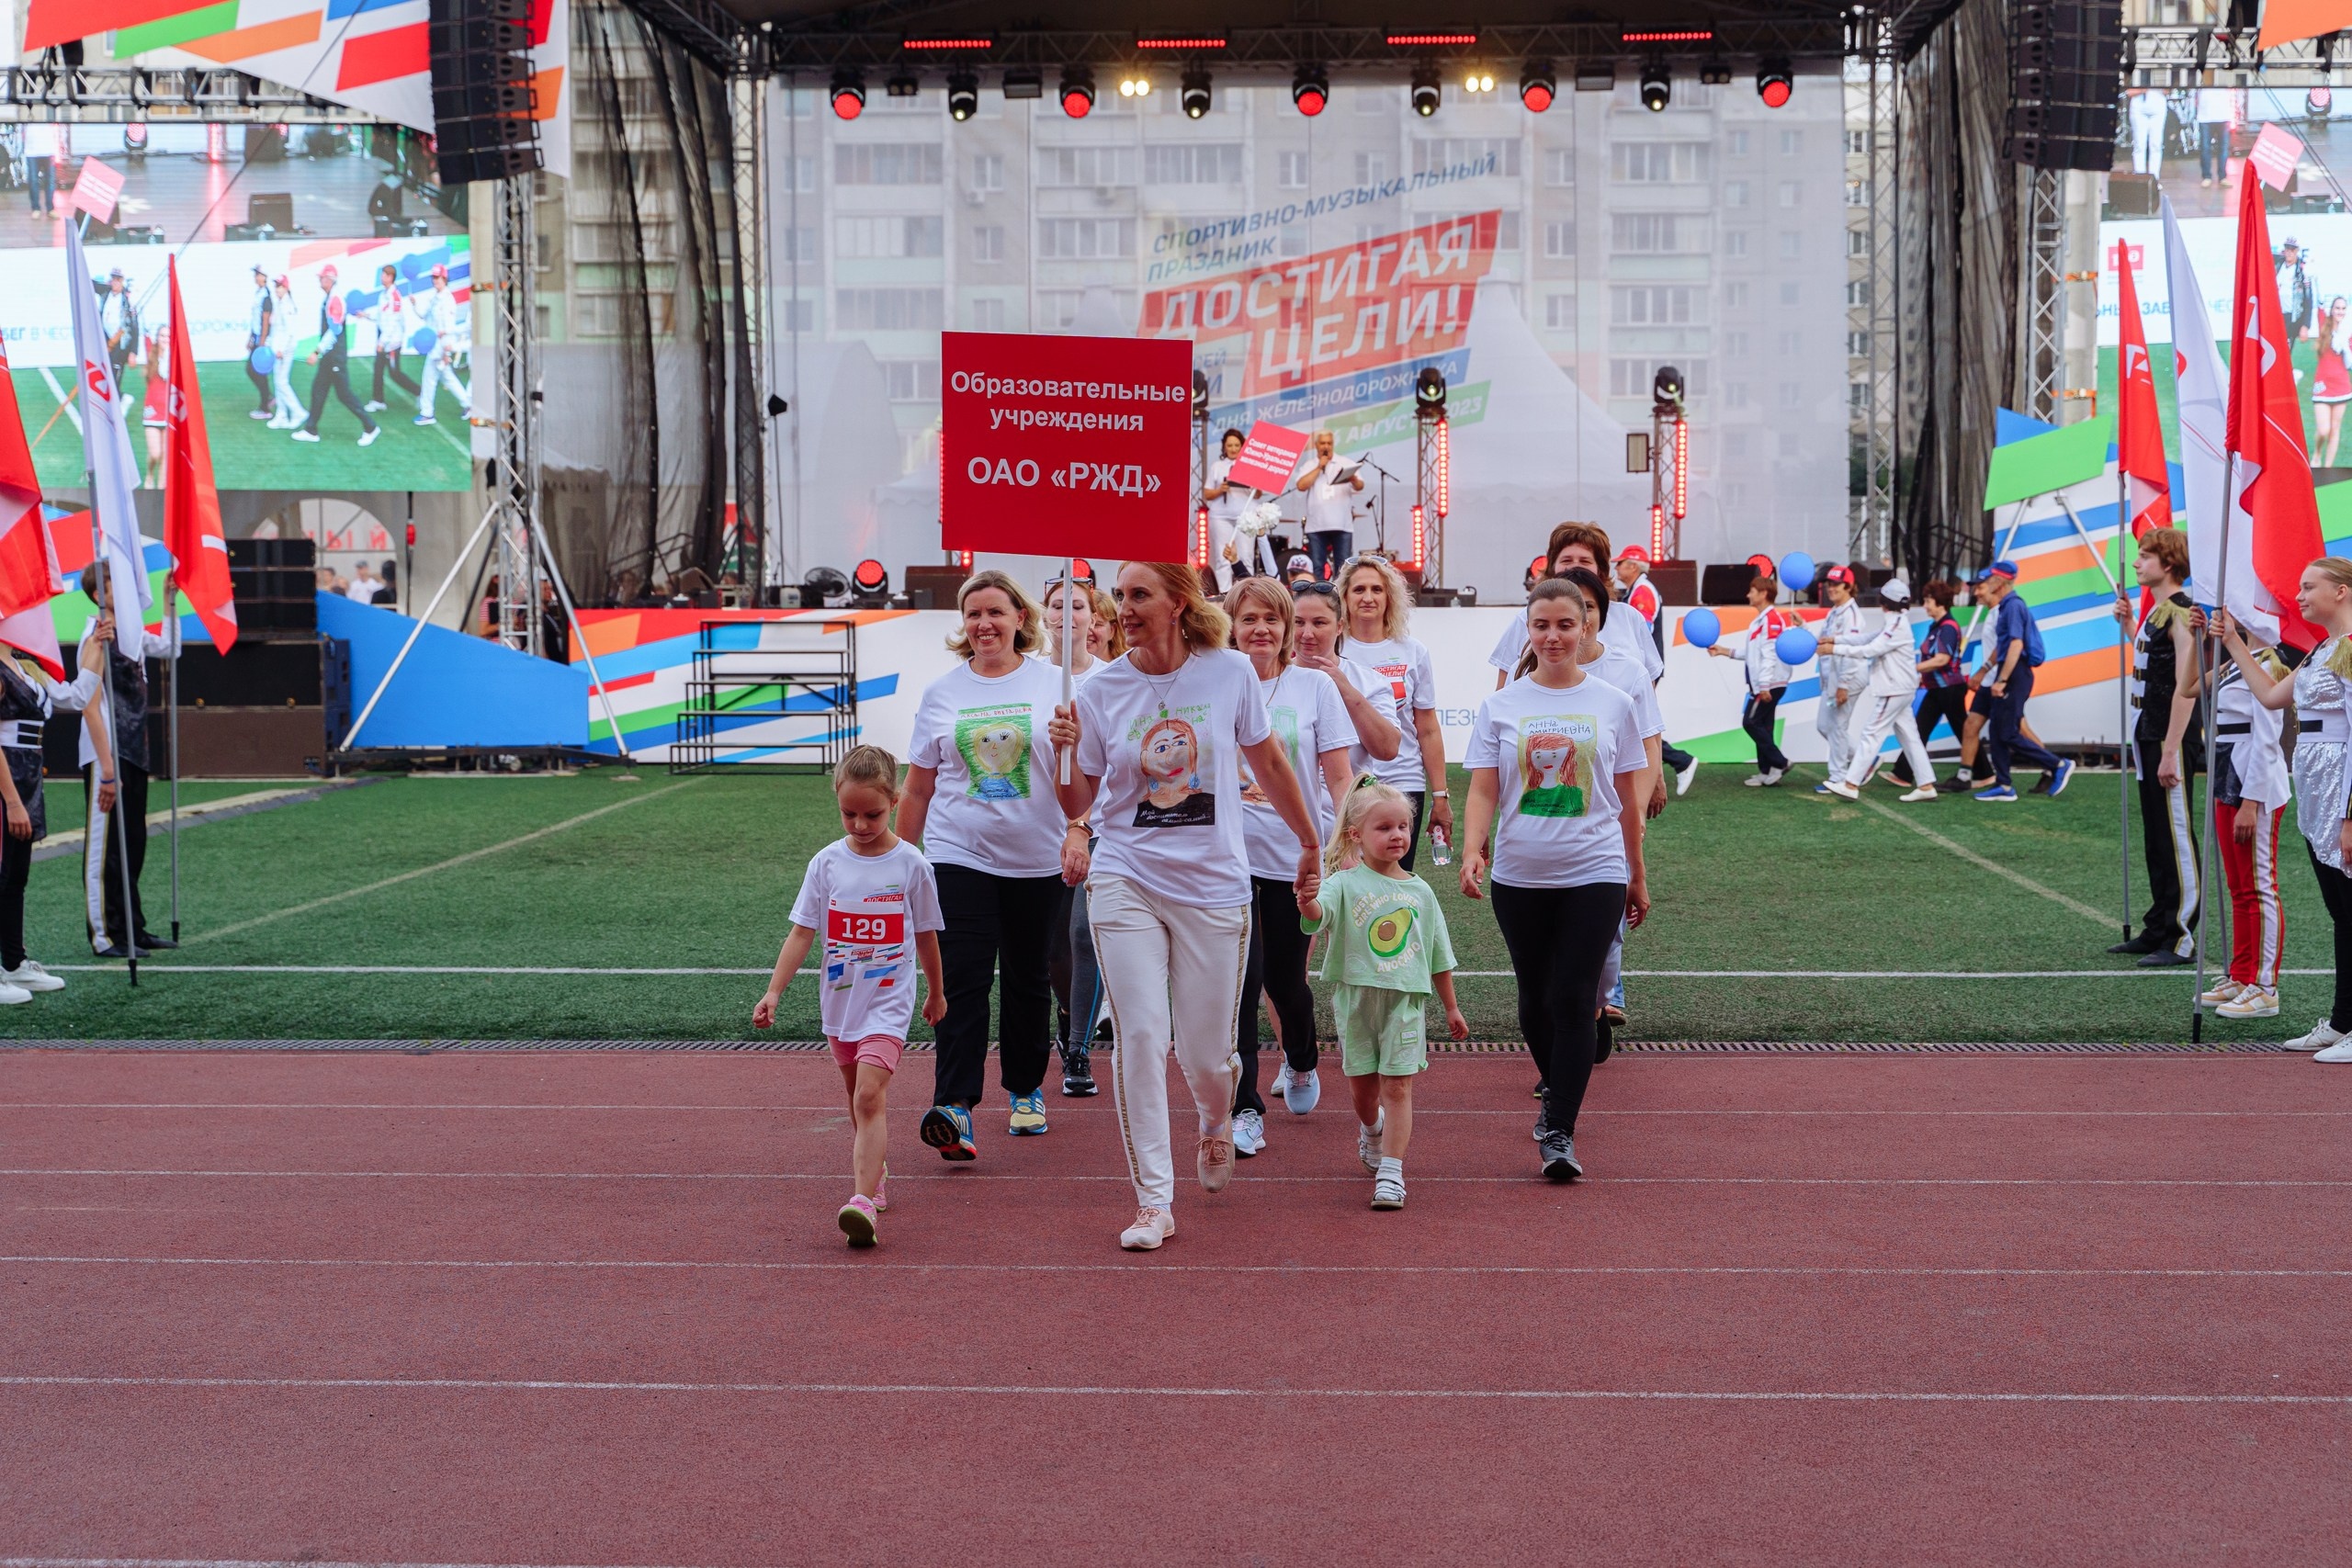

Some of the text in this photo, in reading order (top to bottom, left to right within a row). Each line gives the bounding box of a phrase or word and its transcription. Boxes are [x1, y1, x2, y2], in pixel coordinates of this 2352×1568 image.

[1153, 151, 1498, 254] СПОРТИВНО-МУЗЫКАЛЬНЫЙ
[1148, 235, 1277, 283] ПРАЗДНИК
[1156, 222, 1475, 338] ДОСТИГАЯ
[1259, 283, 1461, 382] ЦЕЛИ!
[951, 371, 1186, 403] Образовательные
[1212, 410, 1252, 436] ДНЯ
[1258, 361, 1457, 423] ЖЕЛЕЗНОДОРОЖНКА
[989, 408, 1144, 432] учреждения
[1345, 413, 1419, 444] АВГУСТ
[1446, 396, 1483, 419] 023
[967, 457, 1161, 498] ОАО «РЖД»
[1351, 895, 1370, 918] JUST
[1354, 892, 1419, 928] GIRL WHO LOVES
[842, 917, 887, 941] 129
[1376, 942, 1421, 973] AVOCADO
